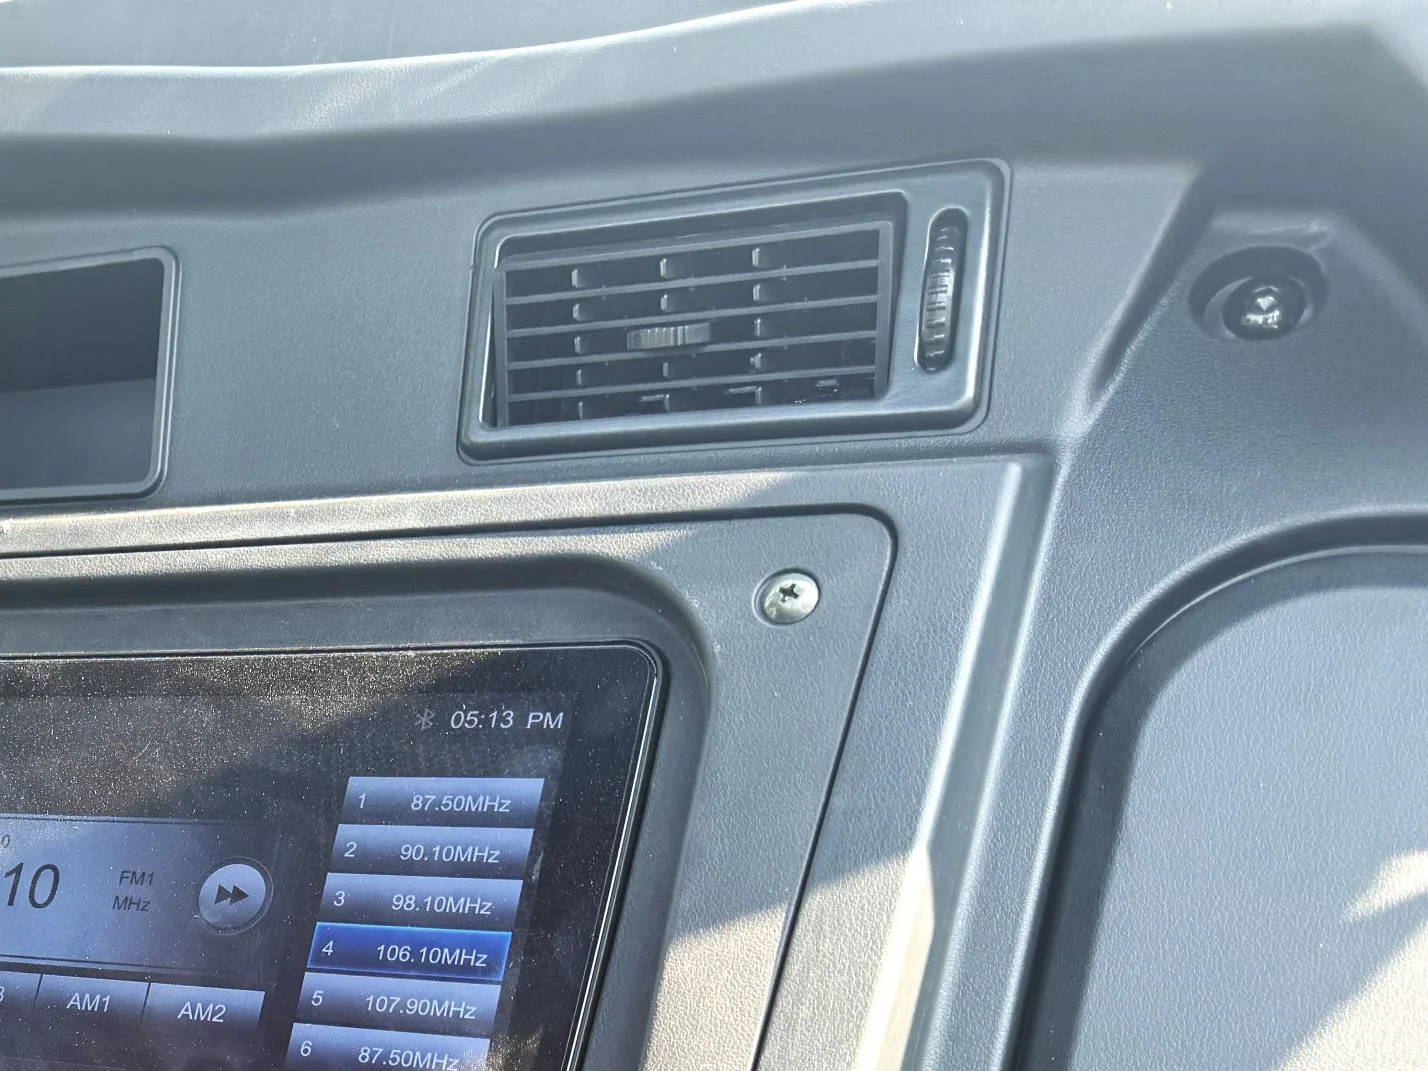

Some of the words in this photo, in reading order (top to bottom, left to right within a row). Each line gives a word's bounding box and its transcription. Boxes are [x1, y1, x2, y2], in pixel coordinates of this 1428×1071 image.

[451, 711, 514, 729] 05:13
[526, 711, 564, 729] PM
[358, 793, 367, 808] 1
[410, 795, 511, 813] 87.50MHz
[344, 842, 357, 857] 2
[399, 845, 500, 863] 90.10MHz
[119, 870, 155, 885] FM1
[112, 897, 151, 912] MHz
[333, 891, 346, 907] 3
[391, 894, 493, 915] 98.10MHz
[322, 940, 334, 956] 4
[376, 944, 488, 967] 106.10MHz
[67, 992, 111, 1013] AM1
[177, 1001, 227, 1023] AM2
[311, 990, 324, 1006] 5
[365, 995, 477, 1020] 107.90MHz
[300, 1040, 312, 1056] 6
[358, 1046, 460, 1071] 87.50MHz
